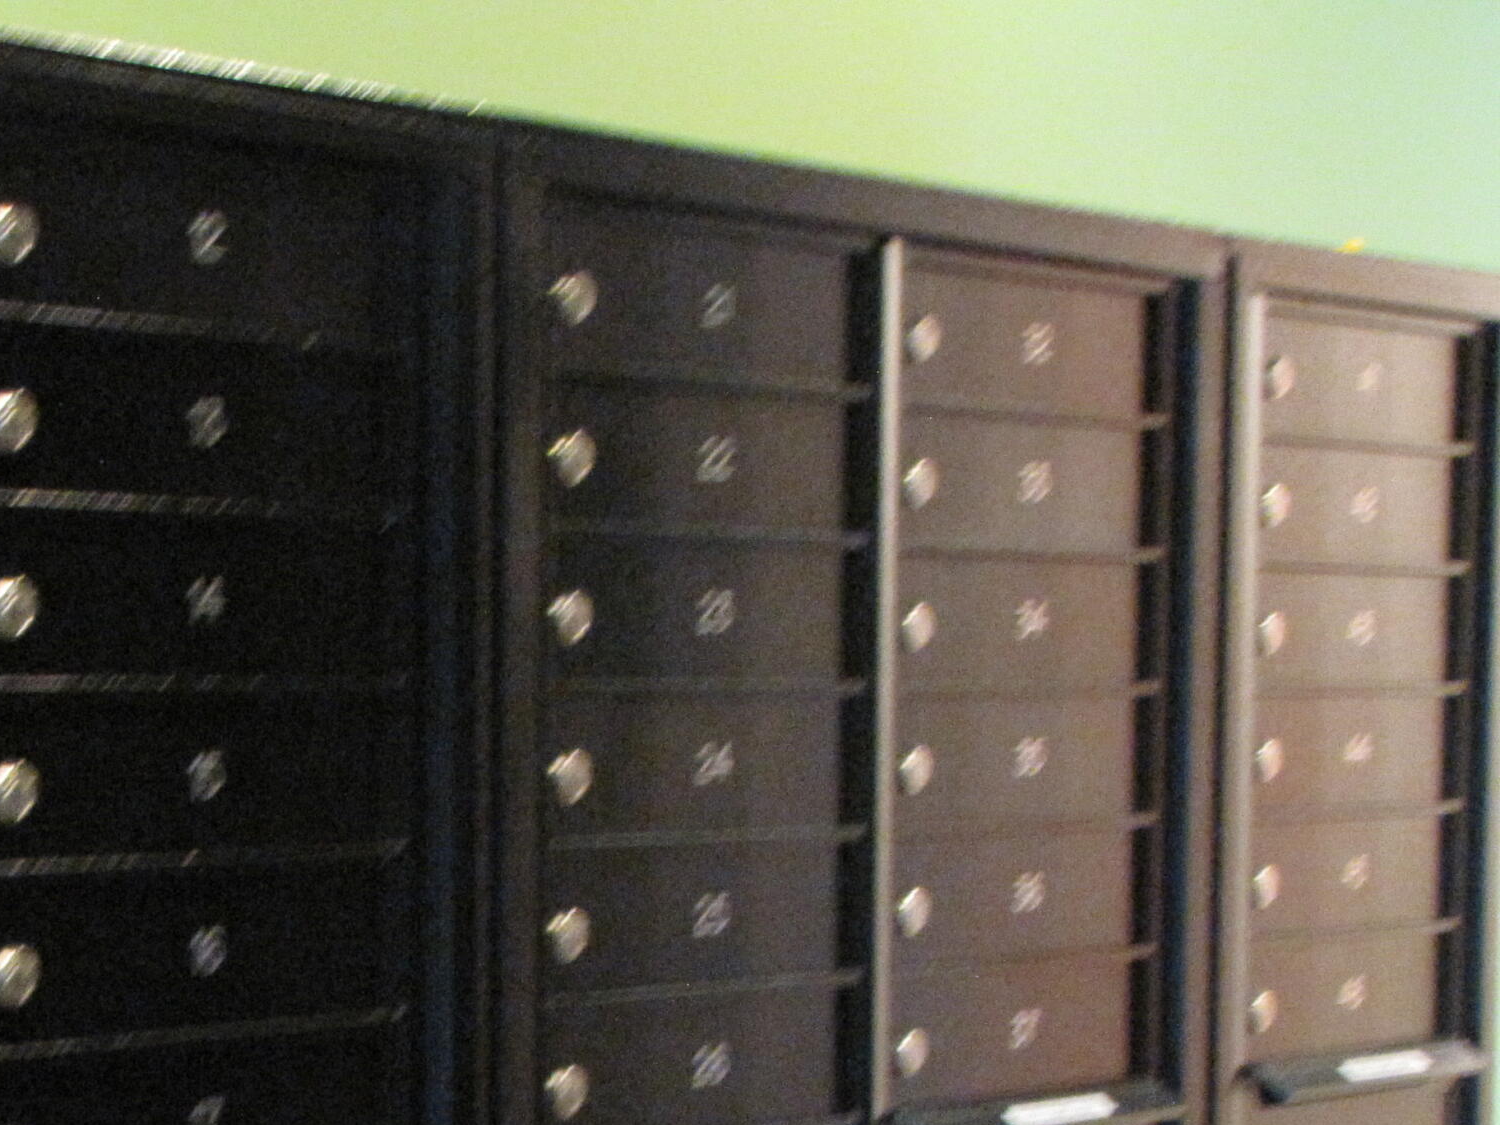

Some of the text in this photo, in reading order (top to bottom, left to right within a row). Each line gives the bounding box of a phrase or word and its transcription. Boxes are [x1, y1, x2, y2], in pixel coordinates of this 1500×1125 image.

[187, 211, 227, 263] 12
[697, 435, 737, 483] 22
[694, 741, 735, 786] 24
